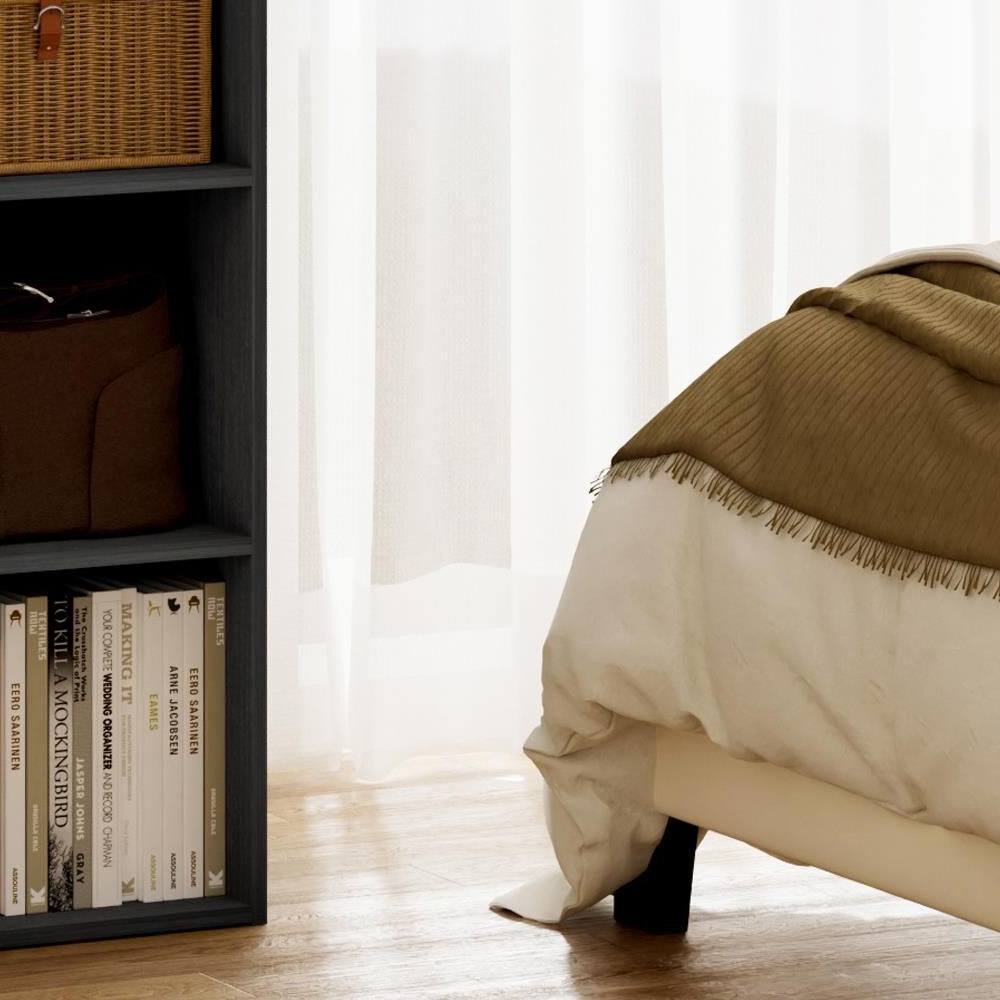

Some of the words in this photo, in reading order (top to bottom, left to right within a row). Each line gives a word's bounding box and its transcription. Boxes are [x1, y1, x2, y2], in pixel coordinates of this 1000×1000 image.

[54, 596, 68, 623] TO
[102, 609, 113, 631] YOUR
[216, 597, 225, 647] TEXTILES
[38, 611, 48, 661] TEXTILES
[54, 629, 68, 669] KILL
[102, 632, 113, 671] COMPLETE
[121, 603, 133, 680] MAKING
[11, 683, 20, 711] EERO
[54, 673, 68, 685] A
[102, 673, 113, 716] WEDDING
[121, 686, 133, 705] IT
[169, 665, 179, 695] ARNE
[190, 667, 199, 696] EERO
[149, 693, 159, 731] EAMES
[169, 698, 179, 756] JACOBSEN
[190, 700, 199, 755] SAARINEN
[11, 715, 20, 771] SAARINEN
[54, 690, 69, 828] MOCKINGBIRD
[102, 718, 113, 770] ORGANIZER
[76, 758, 85, 799] JASPER
[102, 773, 113, 790] AND
[76, 803, 85, 840] JOHNS
[102, 791, 113, 823] RECORD
[102, 826, 113, 868] CHAPMAN
[76, 853, 85, 884] GRAY
